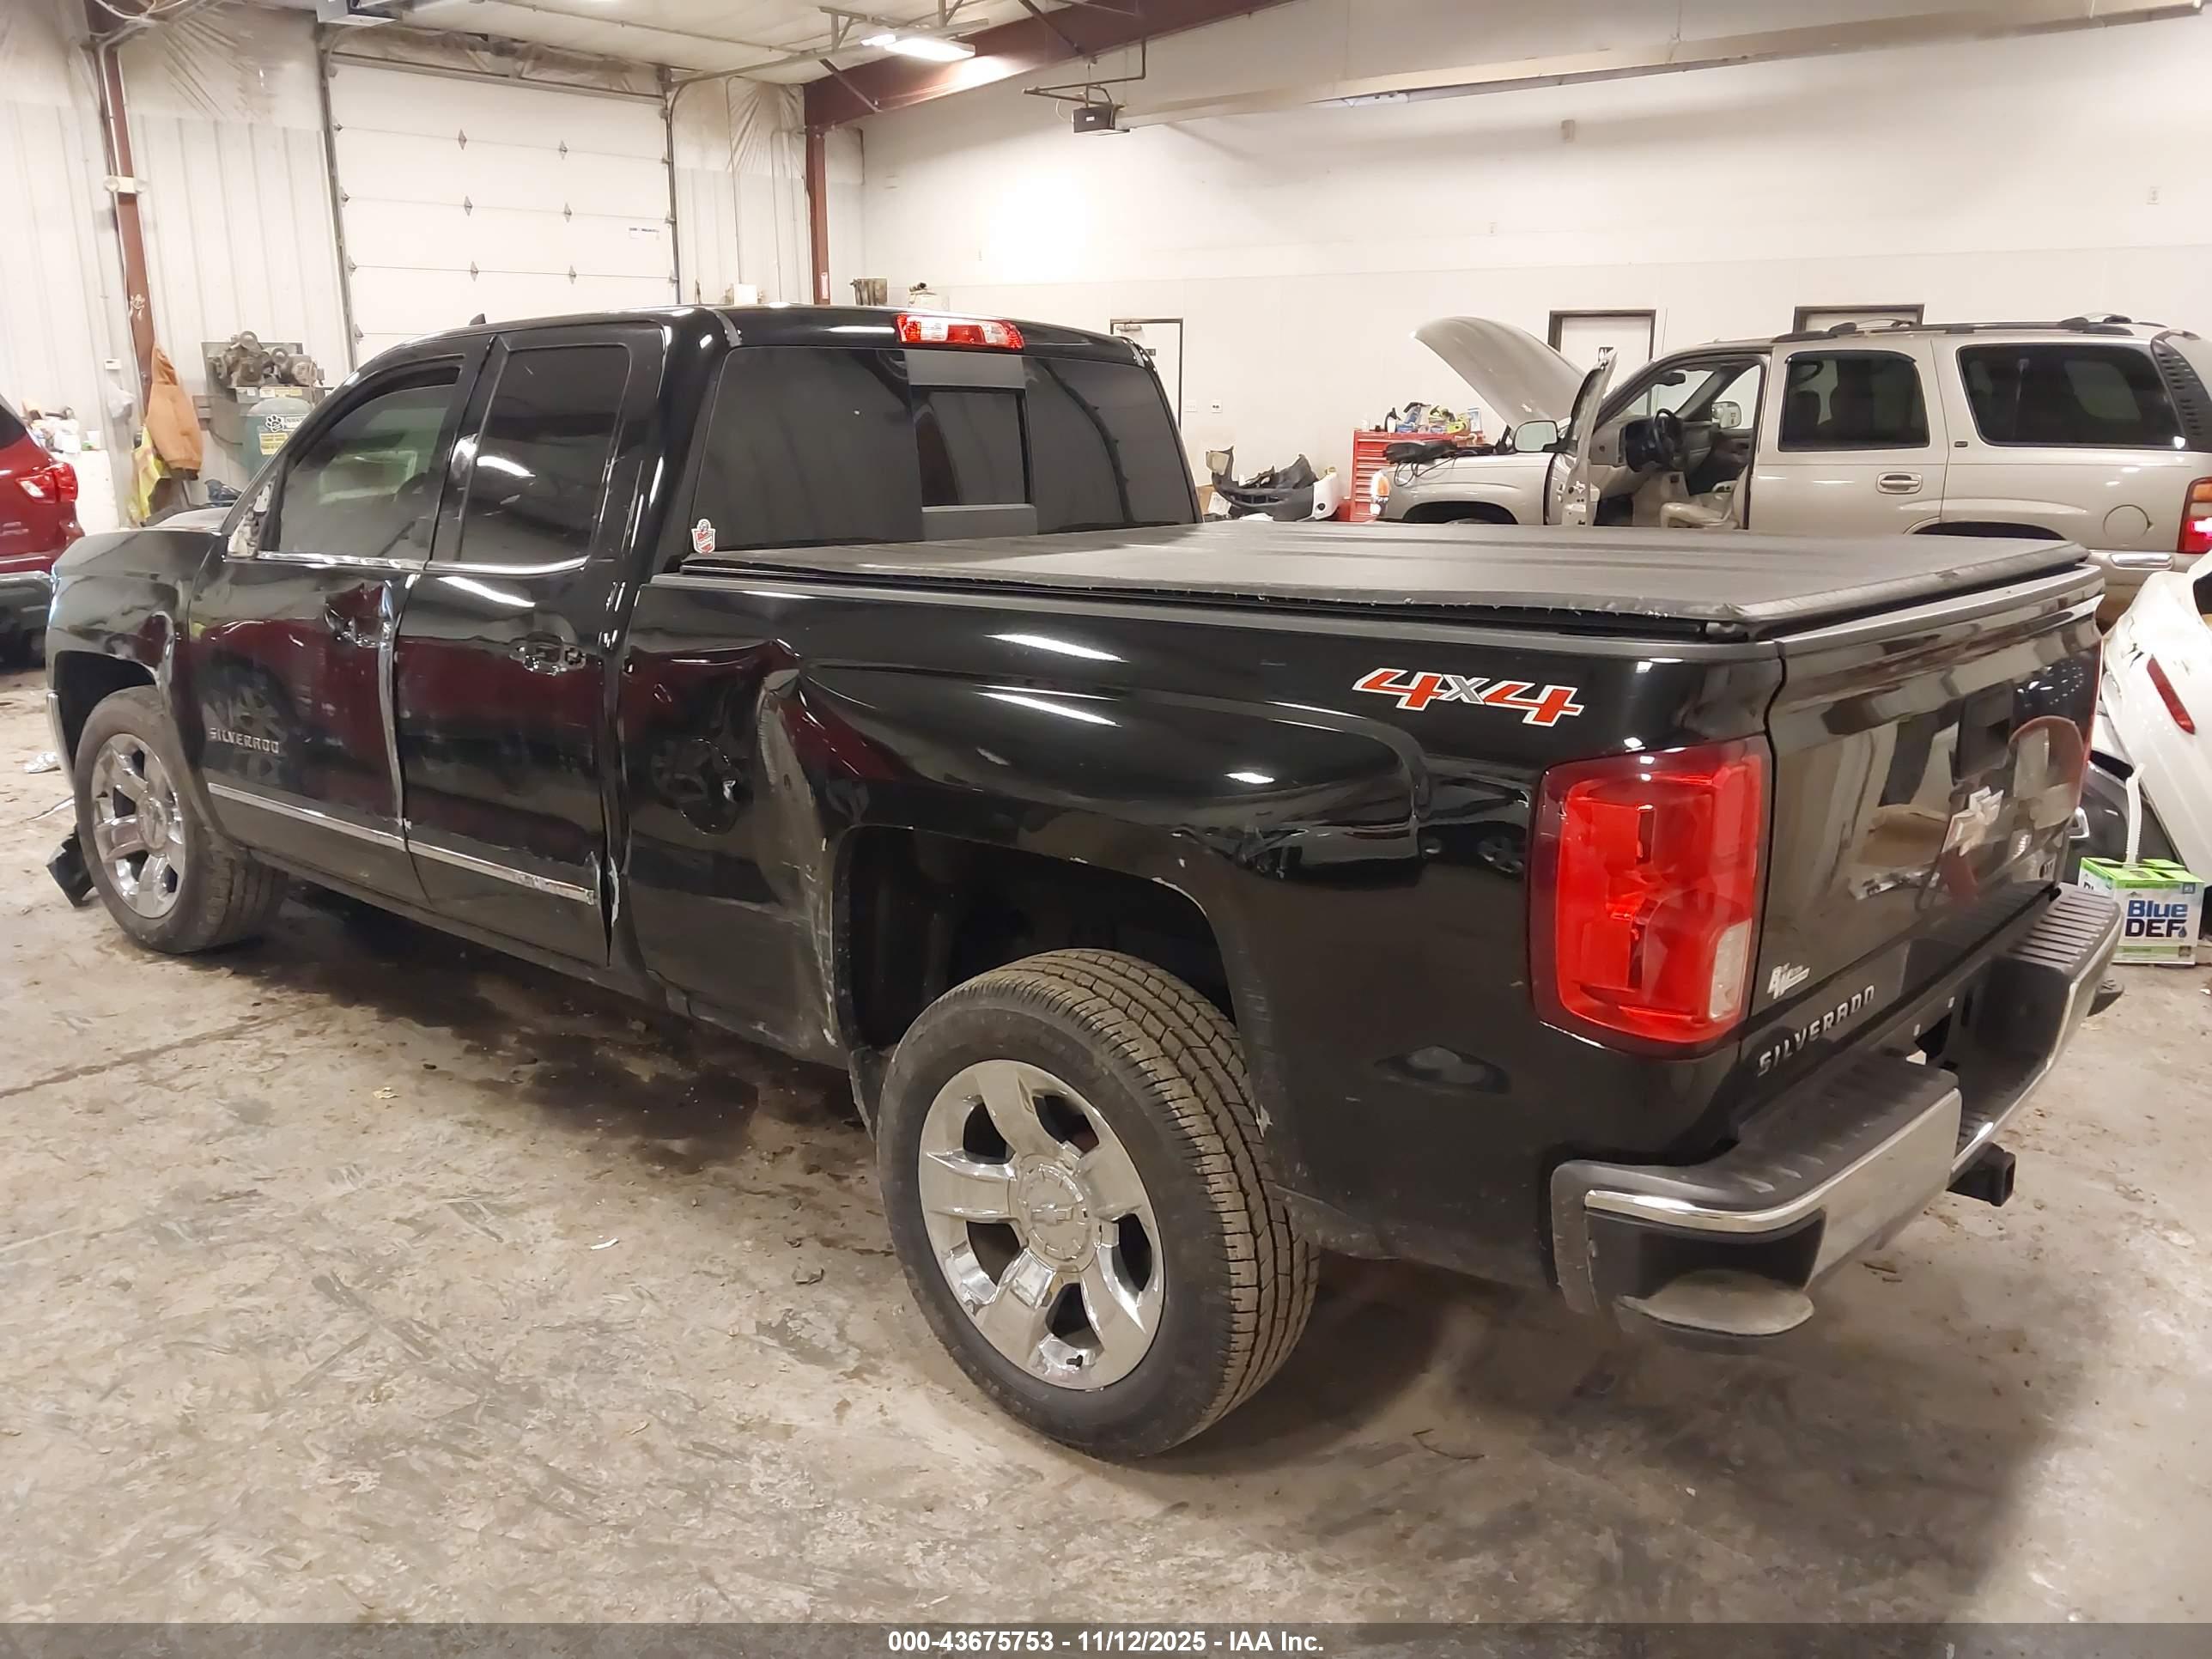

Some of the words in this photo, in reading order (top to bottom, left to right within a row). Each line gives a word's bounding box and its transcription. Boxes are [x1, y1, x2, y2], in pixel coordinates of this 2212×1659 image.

[209, 727, 279, 754] SILVERADO
[2127, 899, 2189, 918] Blue
[2124, 918, 2187, 938] DEF
[1757, 985, 1875, 1077] SILVERADO
